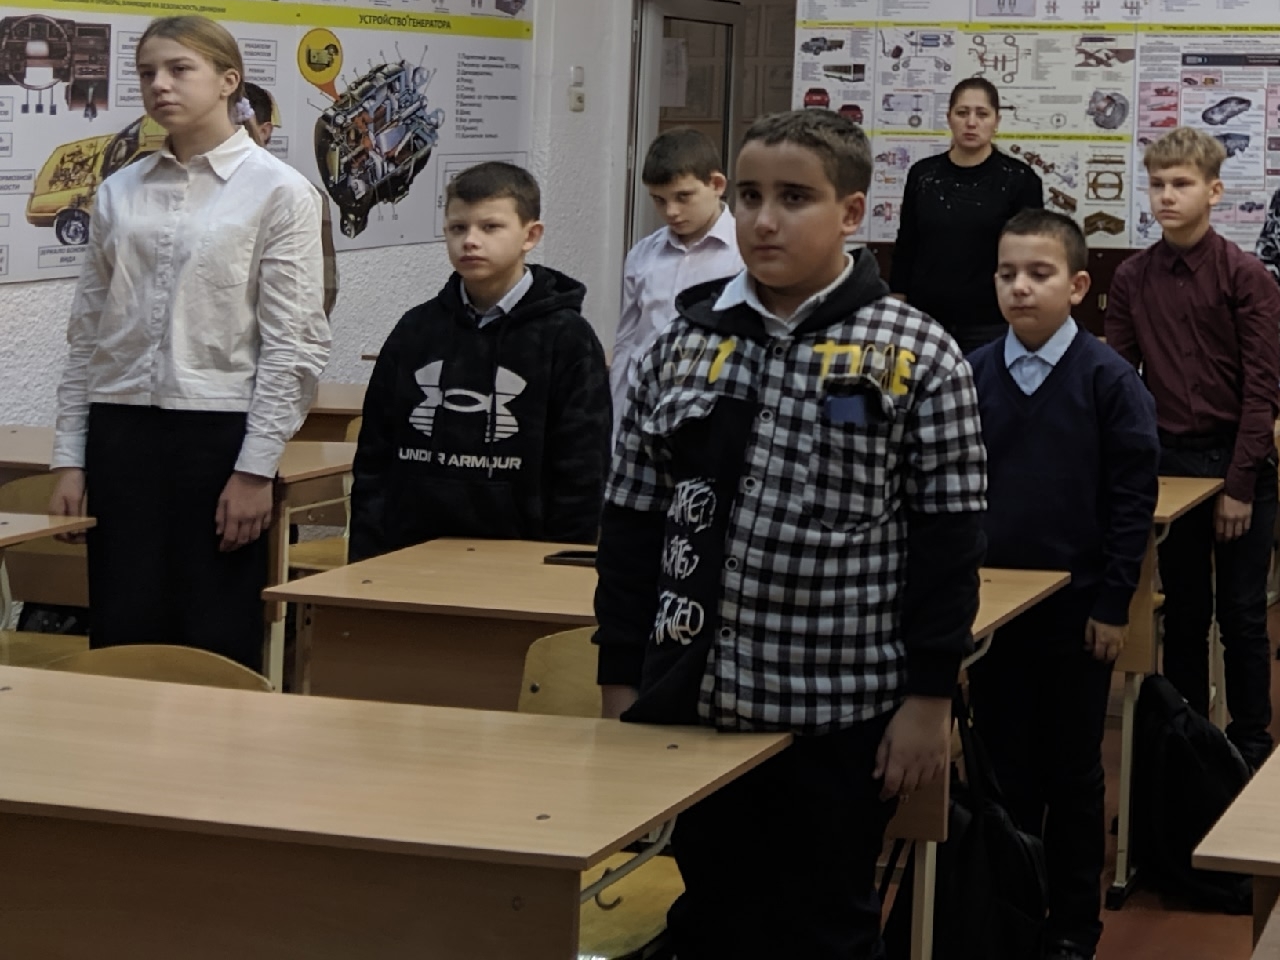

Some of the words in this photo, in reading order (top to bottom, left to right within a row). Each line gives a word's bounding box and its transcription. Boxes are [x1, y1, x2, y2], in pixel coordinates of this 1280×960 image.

[358, 13, 407, 27] УСТРОЙСТВО
[408, 17, 452, 29] ГЕНЕРАТОРА
[448, 454, 523, 470] ARMOUR
